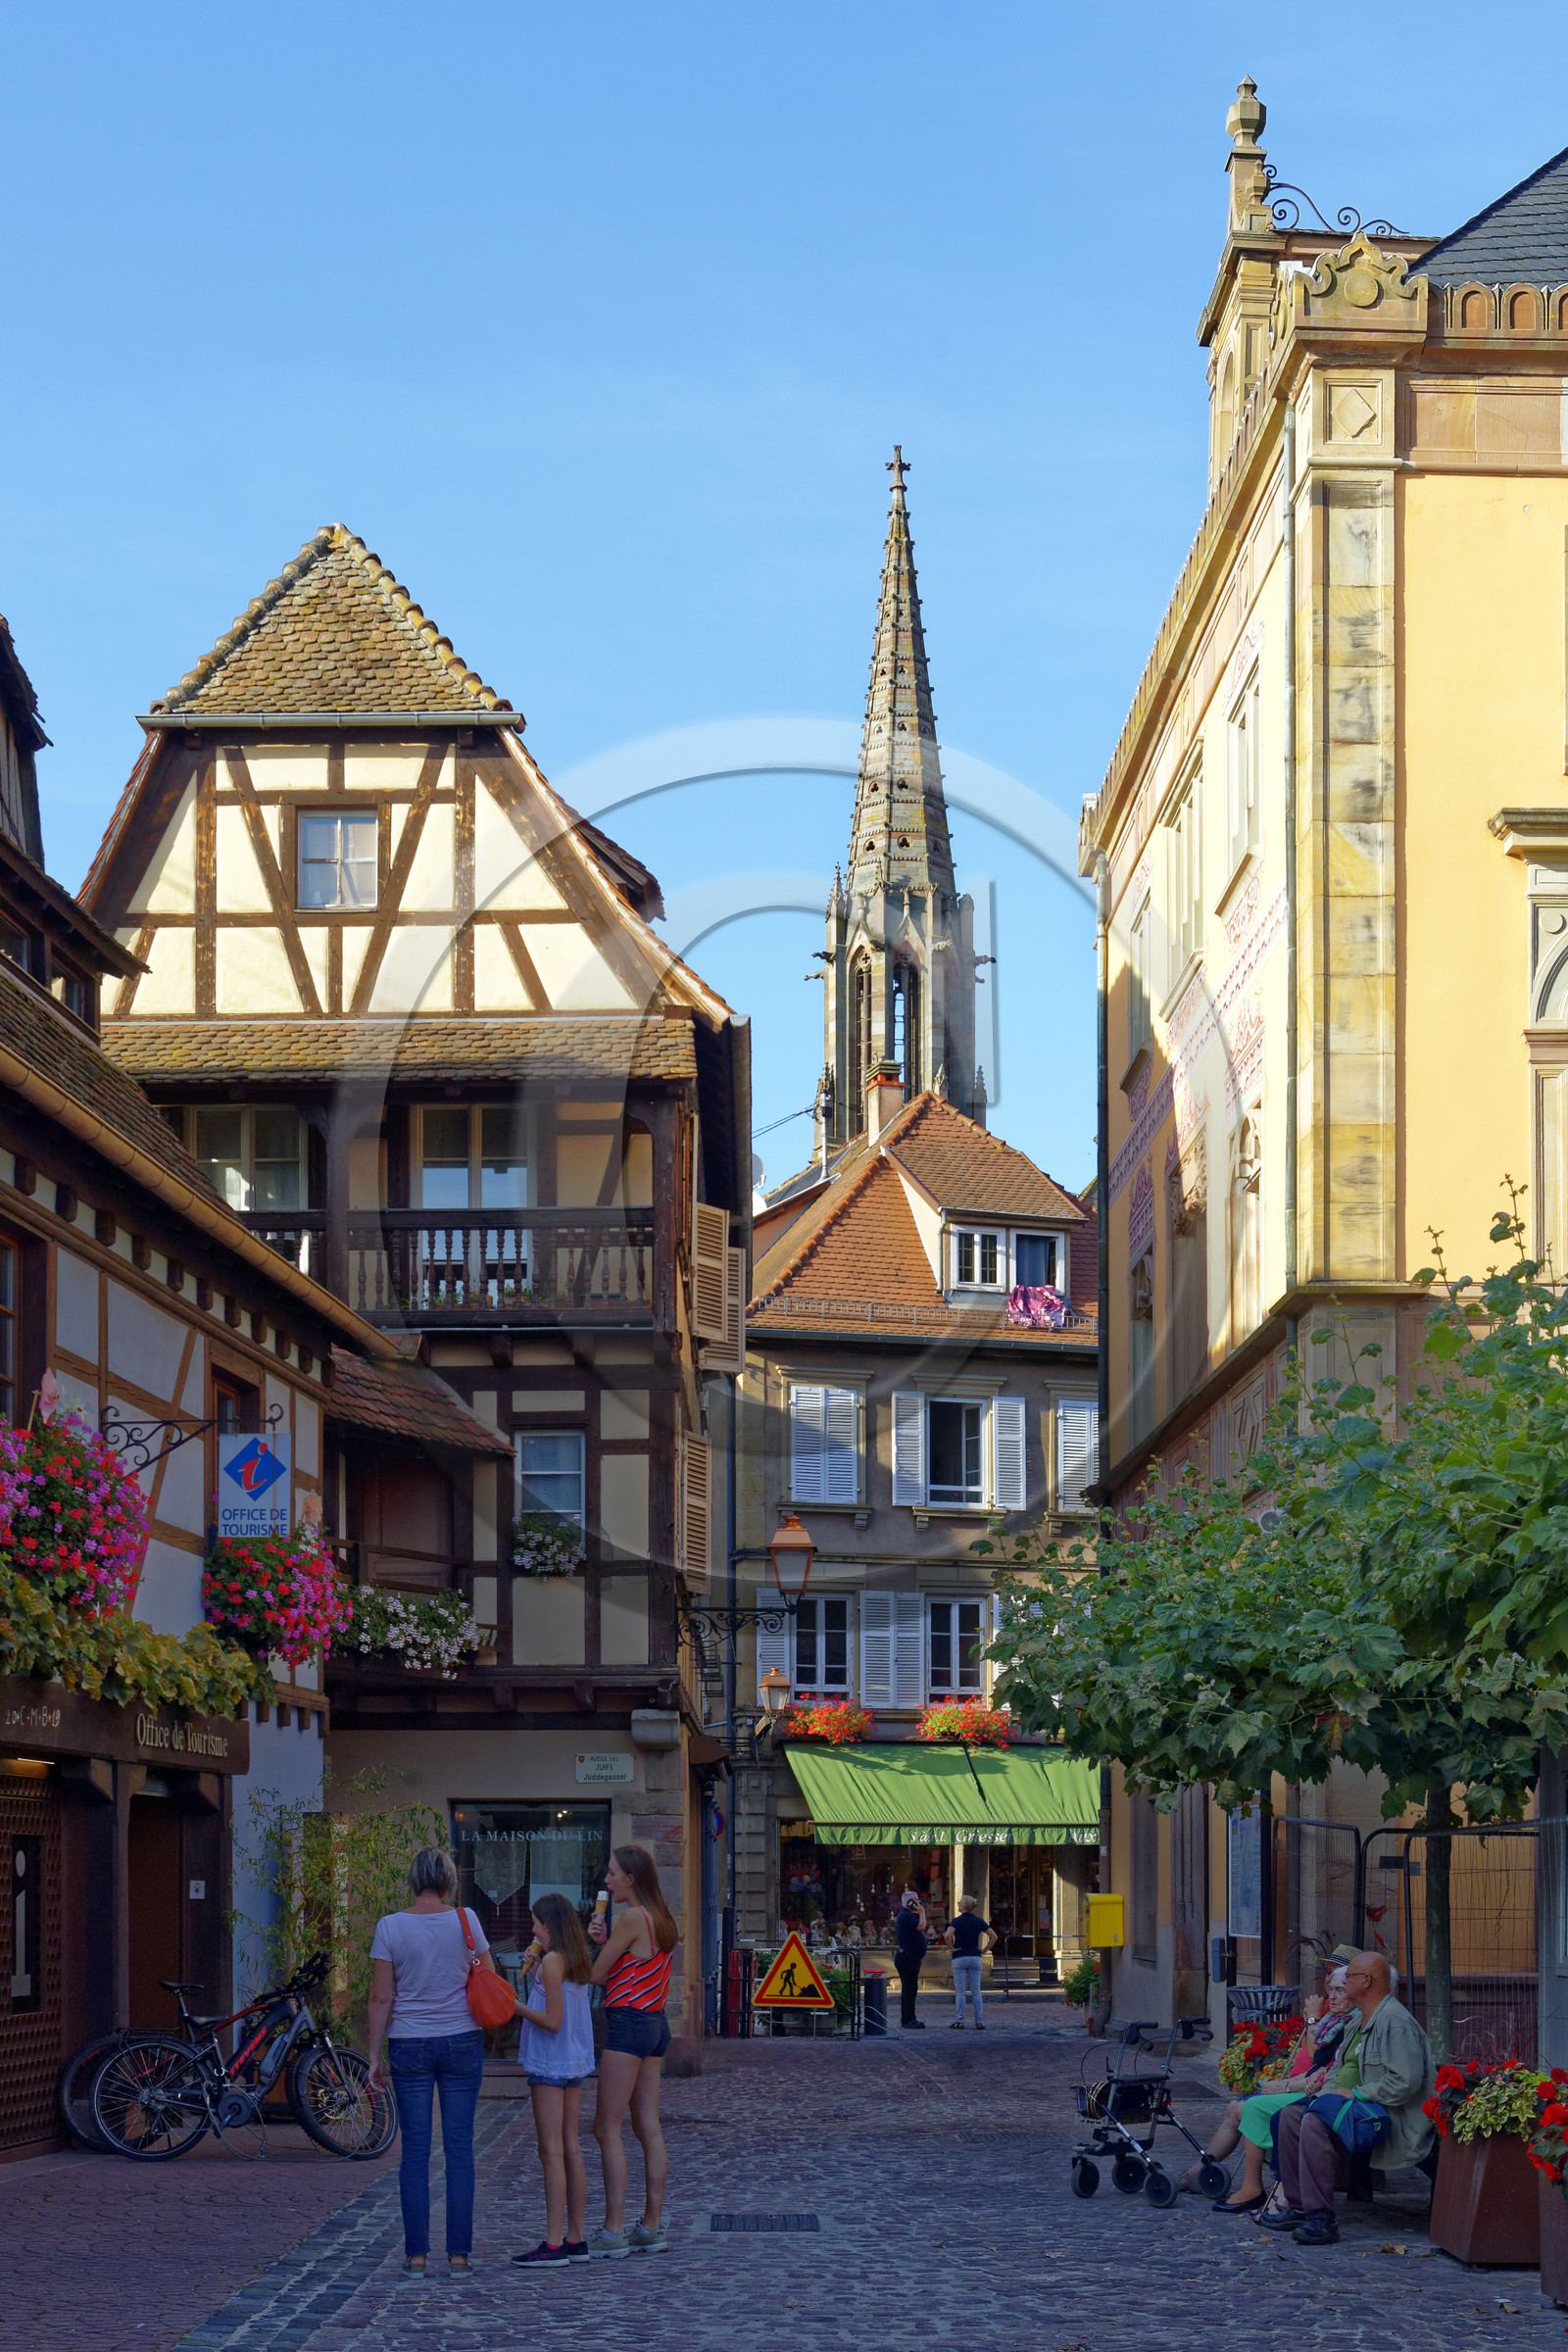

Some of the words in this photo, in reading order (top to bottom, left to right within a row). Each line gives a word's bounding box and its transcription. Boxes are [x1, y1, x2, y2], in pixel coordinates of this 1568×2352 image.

[221, 1508, 267, 1521] OFFICE
[270, 1508, 287, 1521] DE
[221, 1524, 287, 1536] TOURISME
[136, 1712, 170, 1748] Office
[172, 1719, 184, 1751] de
[184, 1721, 228, 1757] Tourisme
[461, 1830, 480, 1841] LA
[486, 1830, 546, 1842] MAISON
[552, 1830, 573, 1842] DU
[578, 1830, 604, 1842] LIN
[956, 1828, 1014, 1843] Griesser
[1067, 1830, 1097, 1843] Aux
[229, 2026, 267, 2078] STEVENS
